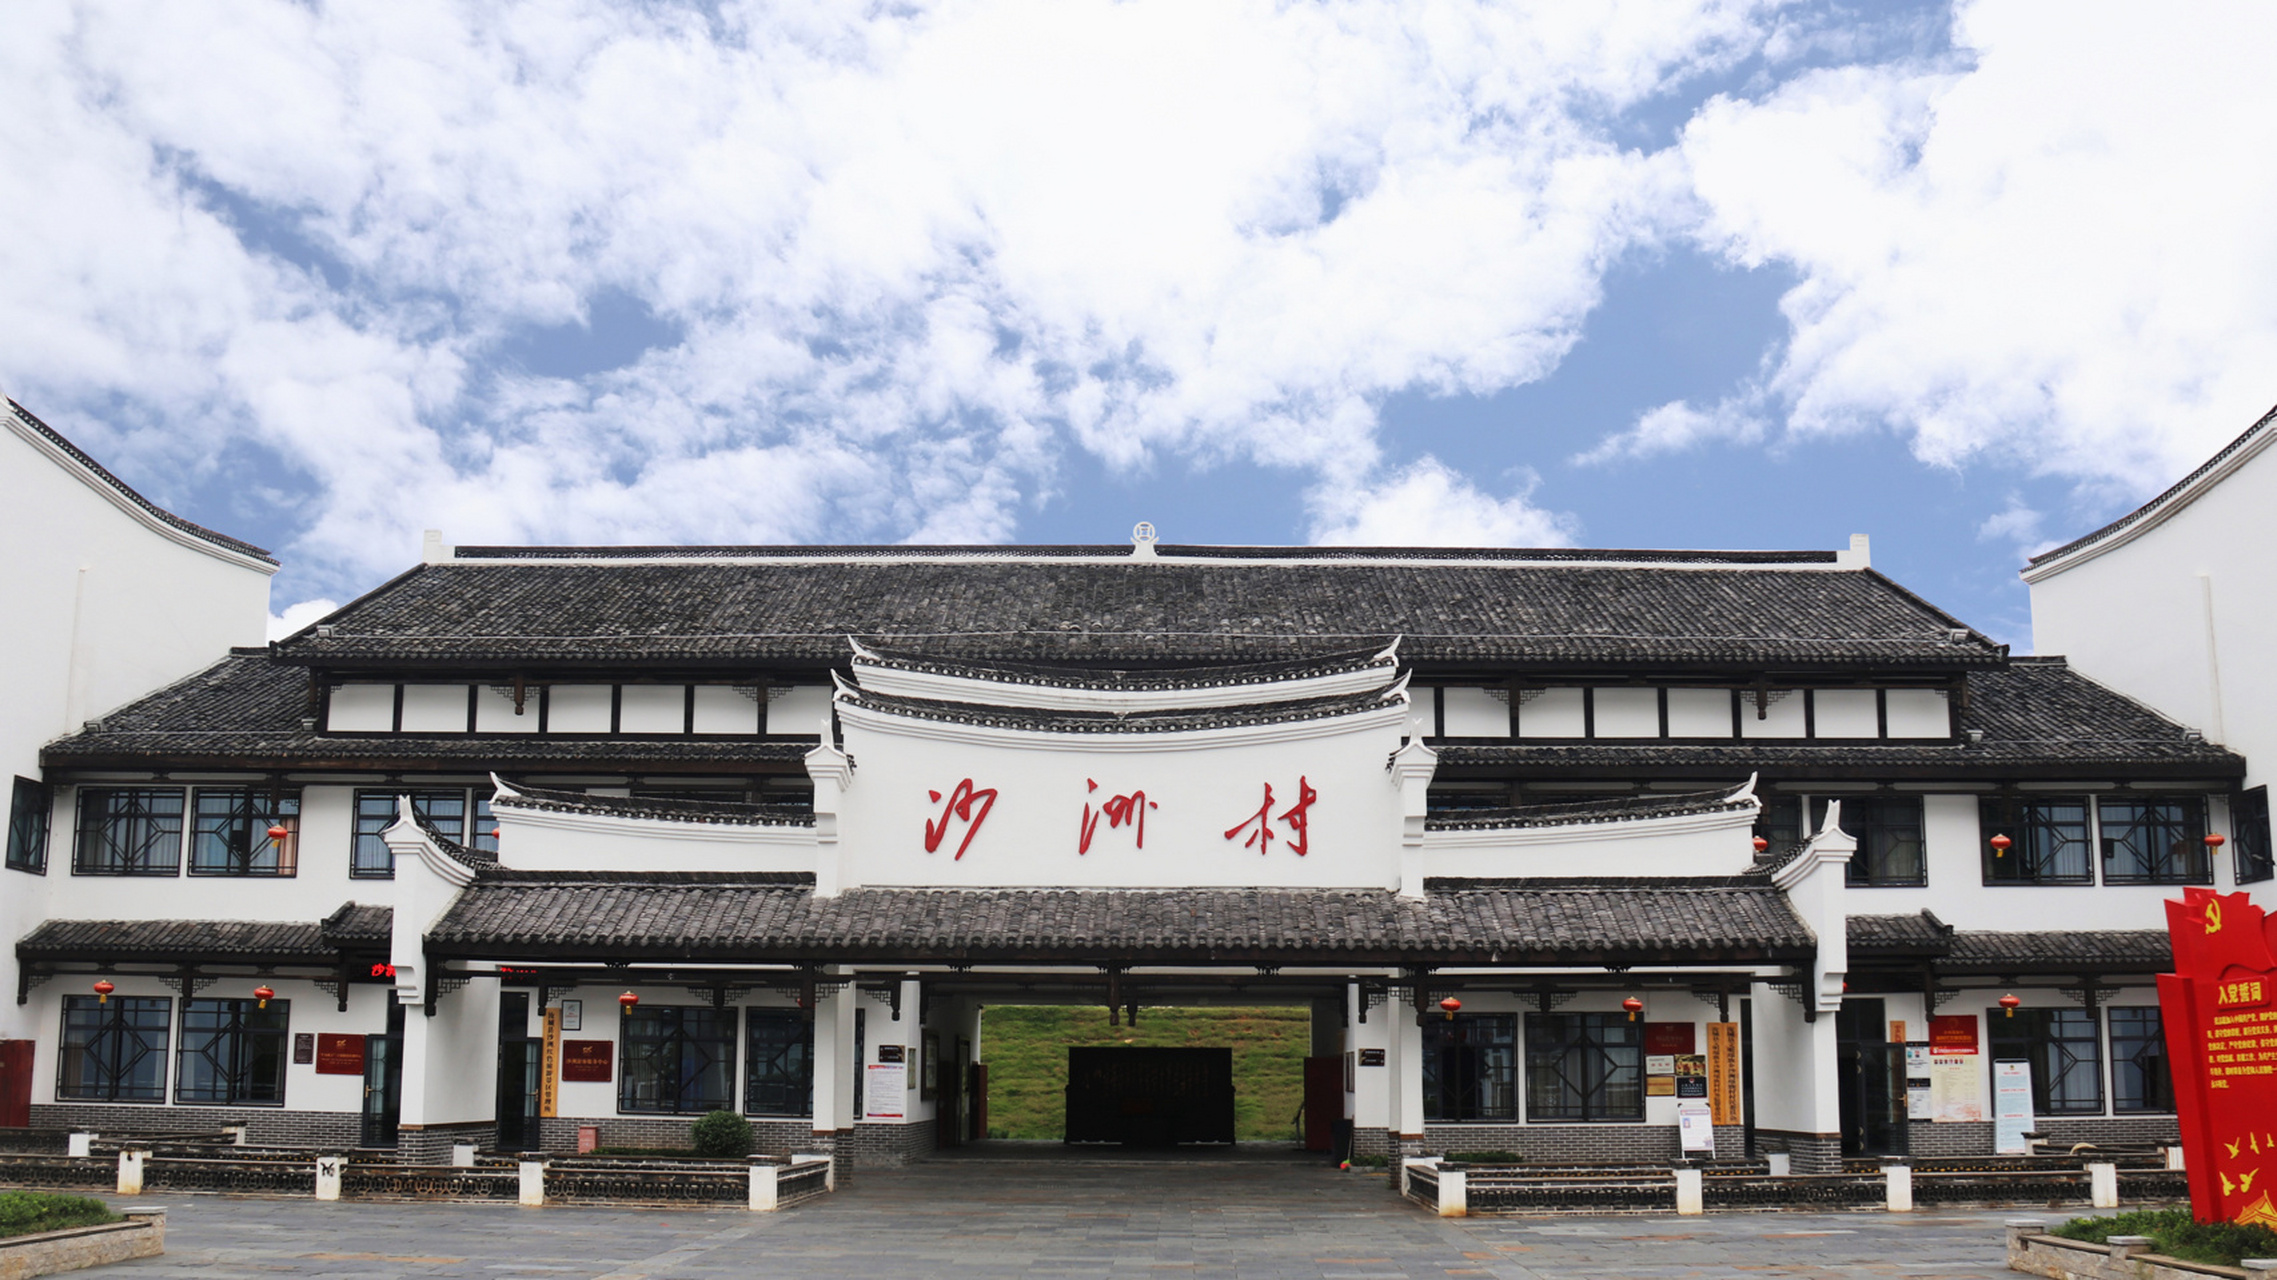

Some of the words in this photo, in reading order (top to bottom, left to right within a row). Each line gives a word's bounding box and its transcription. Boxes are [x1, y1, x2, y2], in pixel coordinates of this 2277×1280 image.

[925, 775, 1316, 861] 沙洲村
[2218, 982, 2261, 1004] 入党誓词
